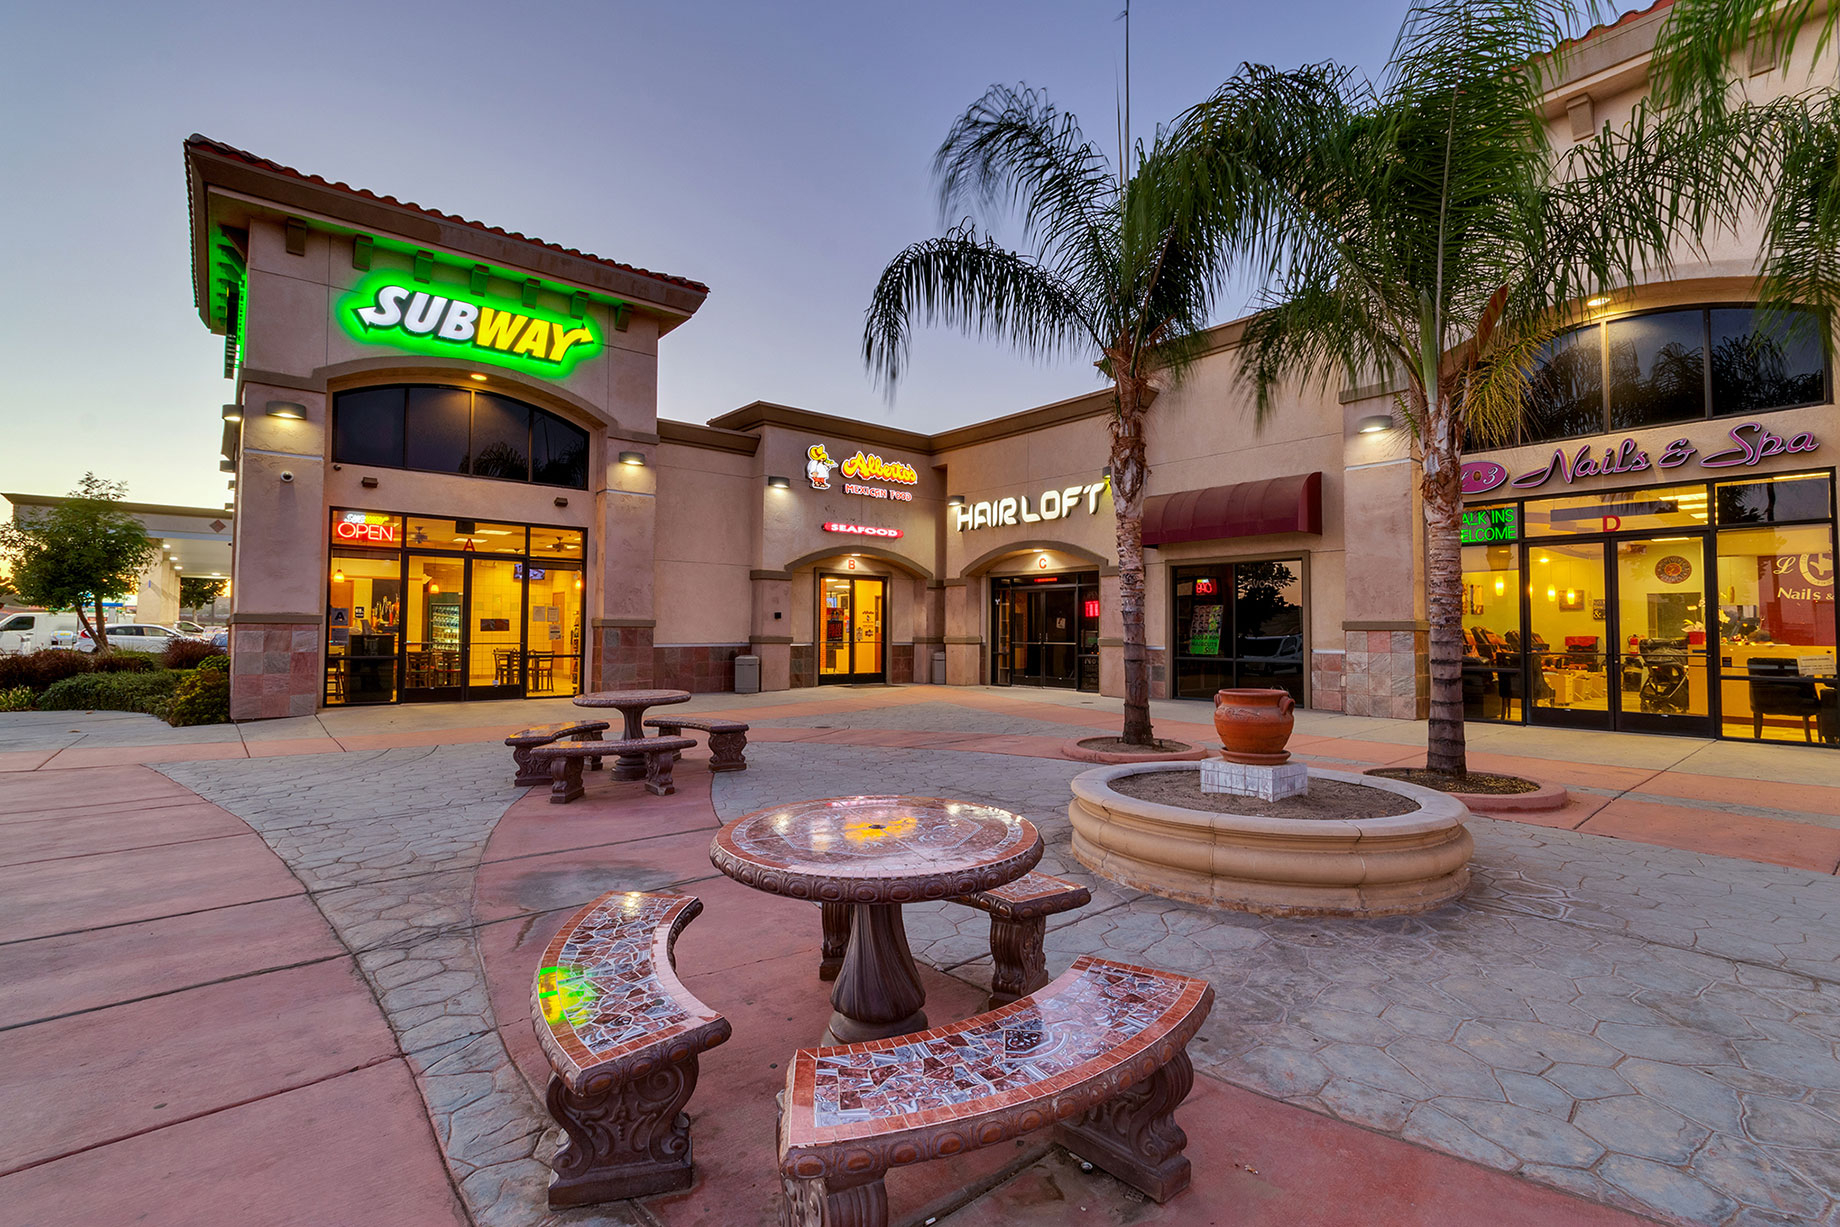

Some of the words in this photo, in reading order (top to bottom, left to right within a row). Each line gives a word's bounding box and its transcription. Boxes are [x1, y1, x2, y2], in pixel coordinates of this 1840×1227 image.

[356, 285, 594, 362] SUBWAY
[1511, 438, 1650, 488] Nails
[1658, 438, 1696, 468] &
[1700, 422, 1819, 468] Spa
[845, 484, 888, 499] MEXICAN
[889, 490, 913, 502] FOOD
[957, 497, 1018, 532] HAIR
[1021, 482, 1106, 523] LOFT
[1461, 511, 1488, 526] ALK
[1491, 508, 1515, 524] INS
[1602, 515, 1622, 533] D
[338, 522, 394, 542] OPEN
[831, 524, 898, 537] SEAFOOD
[1460, 525, 1517, 543] ELCOME
[463, 538, 476, 552] A
[848, 559, 856, 570] B
[1038, 558, 1048, 569] C
[1777, 587, 1822, 601] Nails
